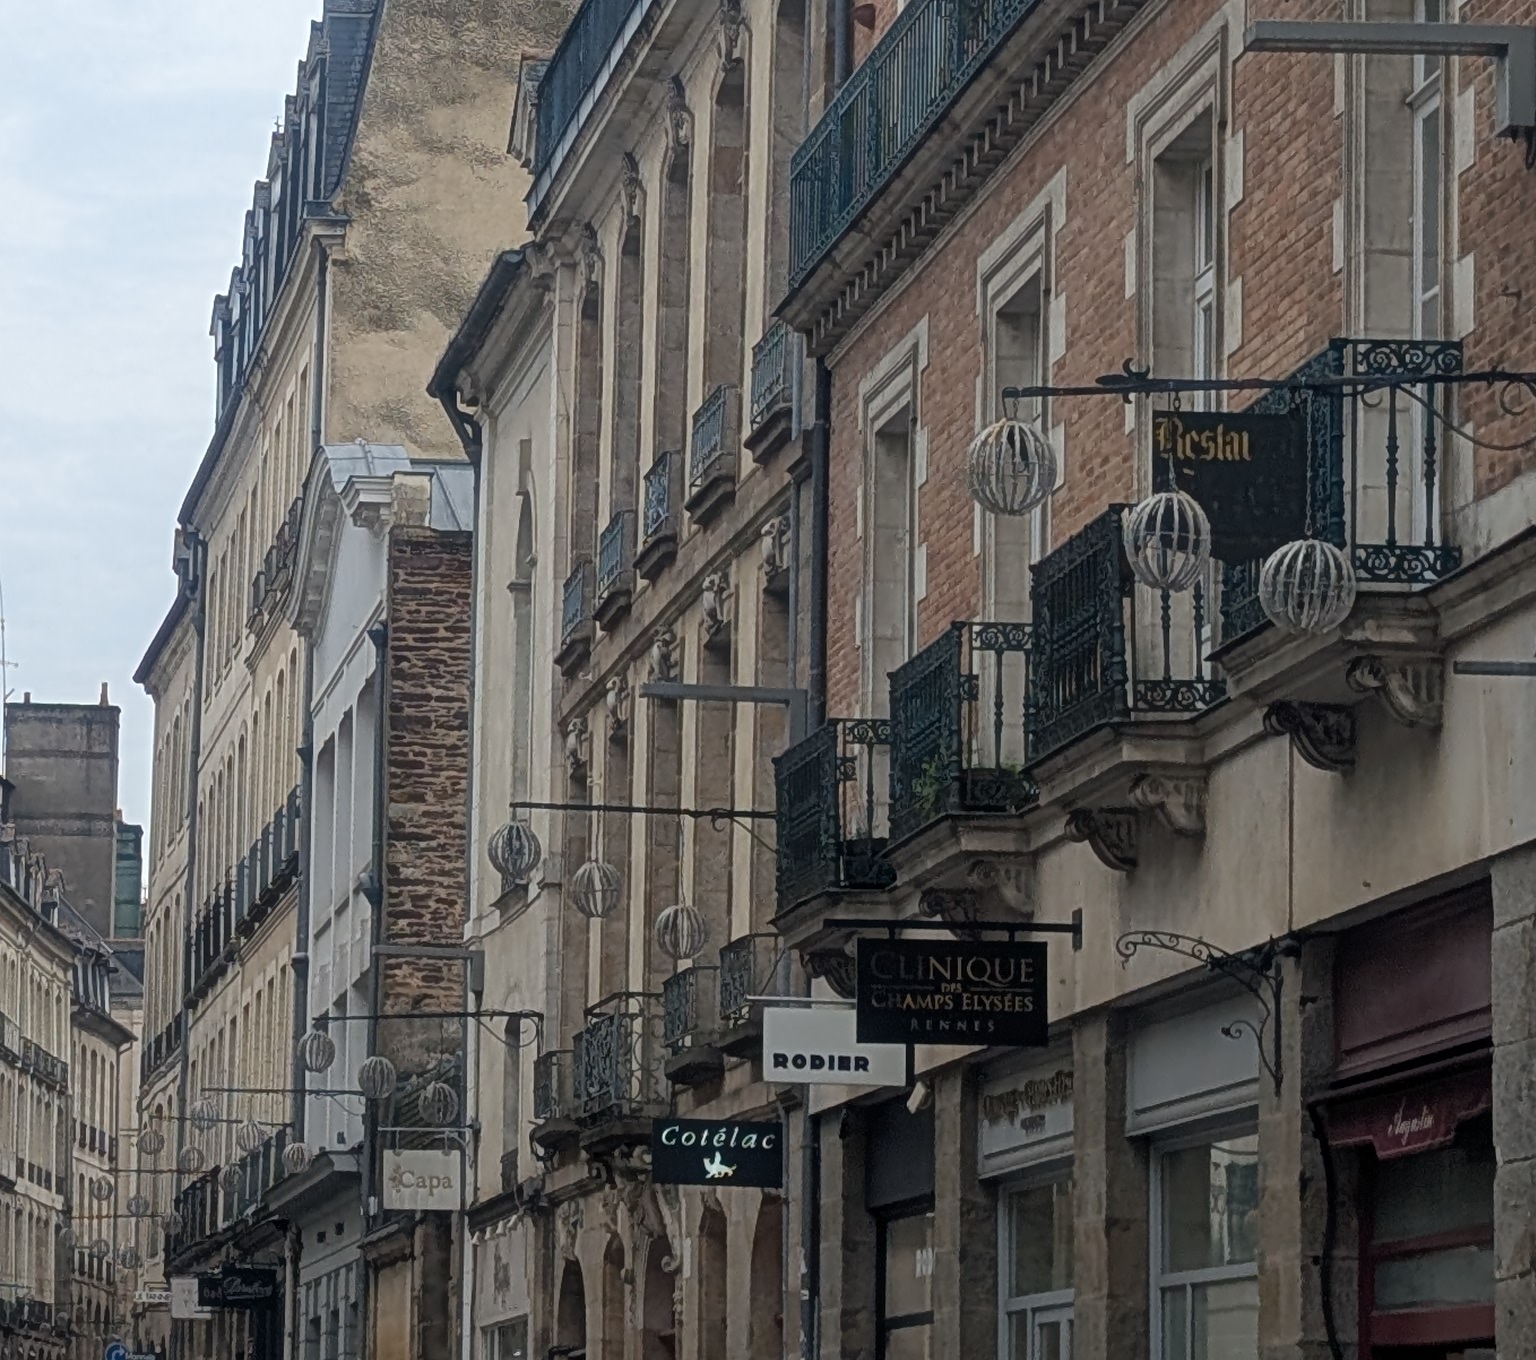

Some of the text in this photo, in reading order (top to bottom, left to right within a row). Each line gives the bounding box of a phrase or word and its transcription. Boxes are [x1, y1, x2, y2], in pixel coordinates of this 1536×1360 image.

[869, 951, 1035, 988] CLINIQUE
[870, 991, 954, 1011] CHAMPS
[910, 1018, 996, 1032] RENNES
[772, 1052, 870, 1073] RODIER
[660, 1122, 776, 1151] Cotélac
[399, 1169, 454, 1197] Capa
